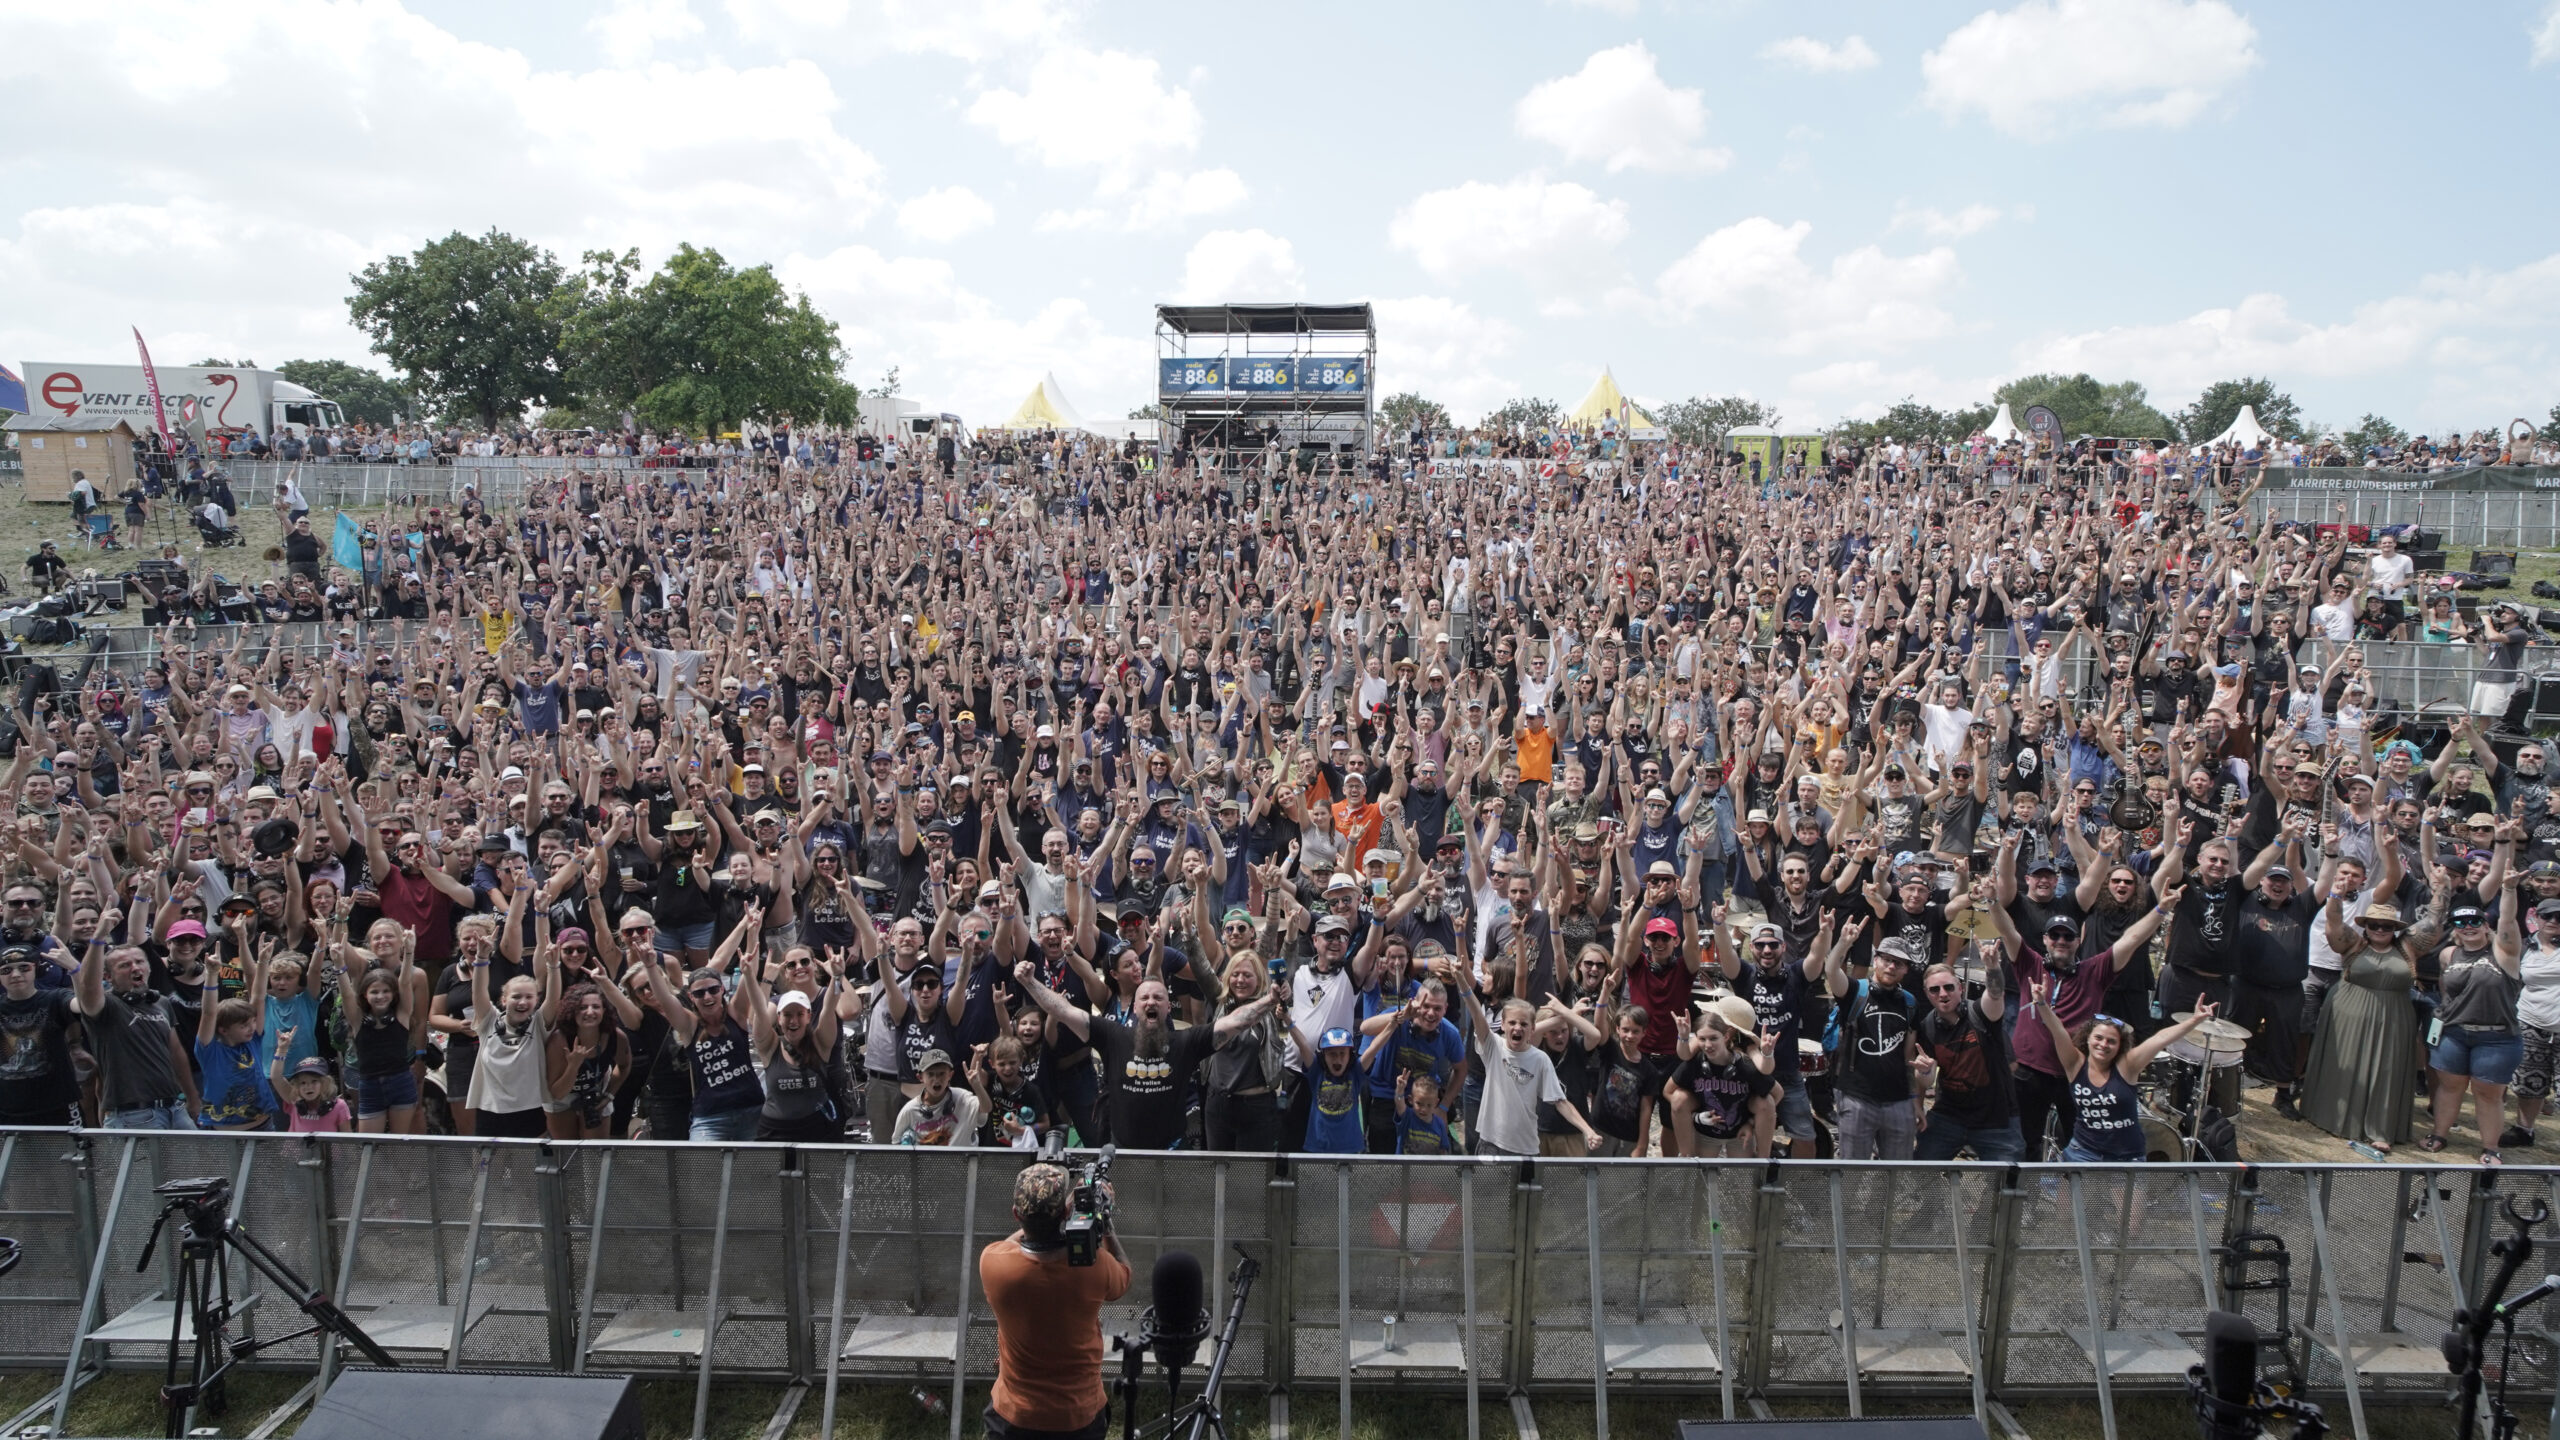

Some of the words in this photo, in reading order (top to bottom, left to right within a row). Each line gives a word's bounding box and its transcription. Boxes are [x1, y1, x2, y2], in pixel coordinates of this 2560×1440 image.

[2096, 440, 2116, 448] EAT
[2290, 478, 2435, 490] KARRIERE.BUNDESHEER.AT
[1753, 983, 1768, 995] So
[1753, 993, 1784, 1005] rockt
[1754, 1004, 1778, 1014] das
[695, 1039, 712, 1053] So
[698, 1039, 734, 1063] rockt
[702, 1058, 730, 1076] das
[707, 1062, 751, 1088] Leben.
[1122, 1084, 1144, 1092] Krügen
[1694, 1077, 1751, 1096] Babygirl
[2074, 1083, 2092, 1096] So
[2075, 1093, 2117, 1107] rockt
[2081, 1107, 2111, 1118] das
[2083, 1117, 2135, 1130] Leben.
